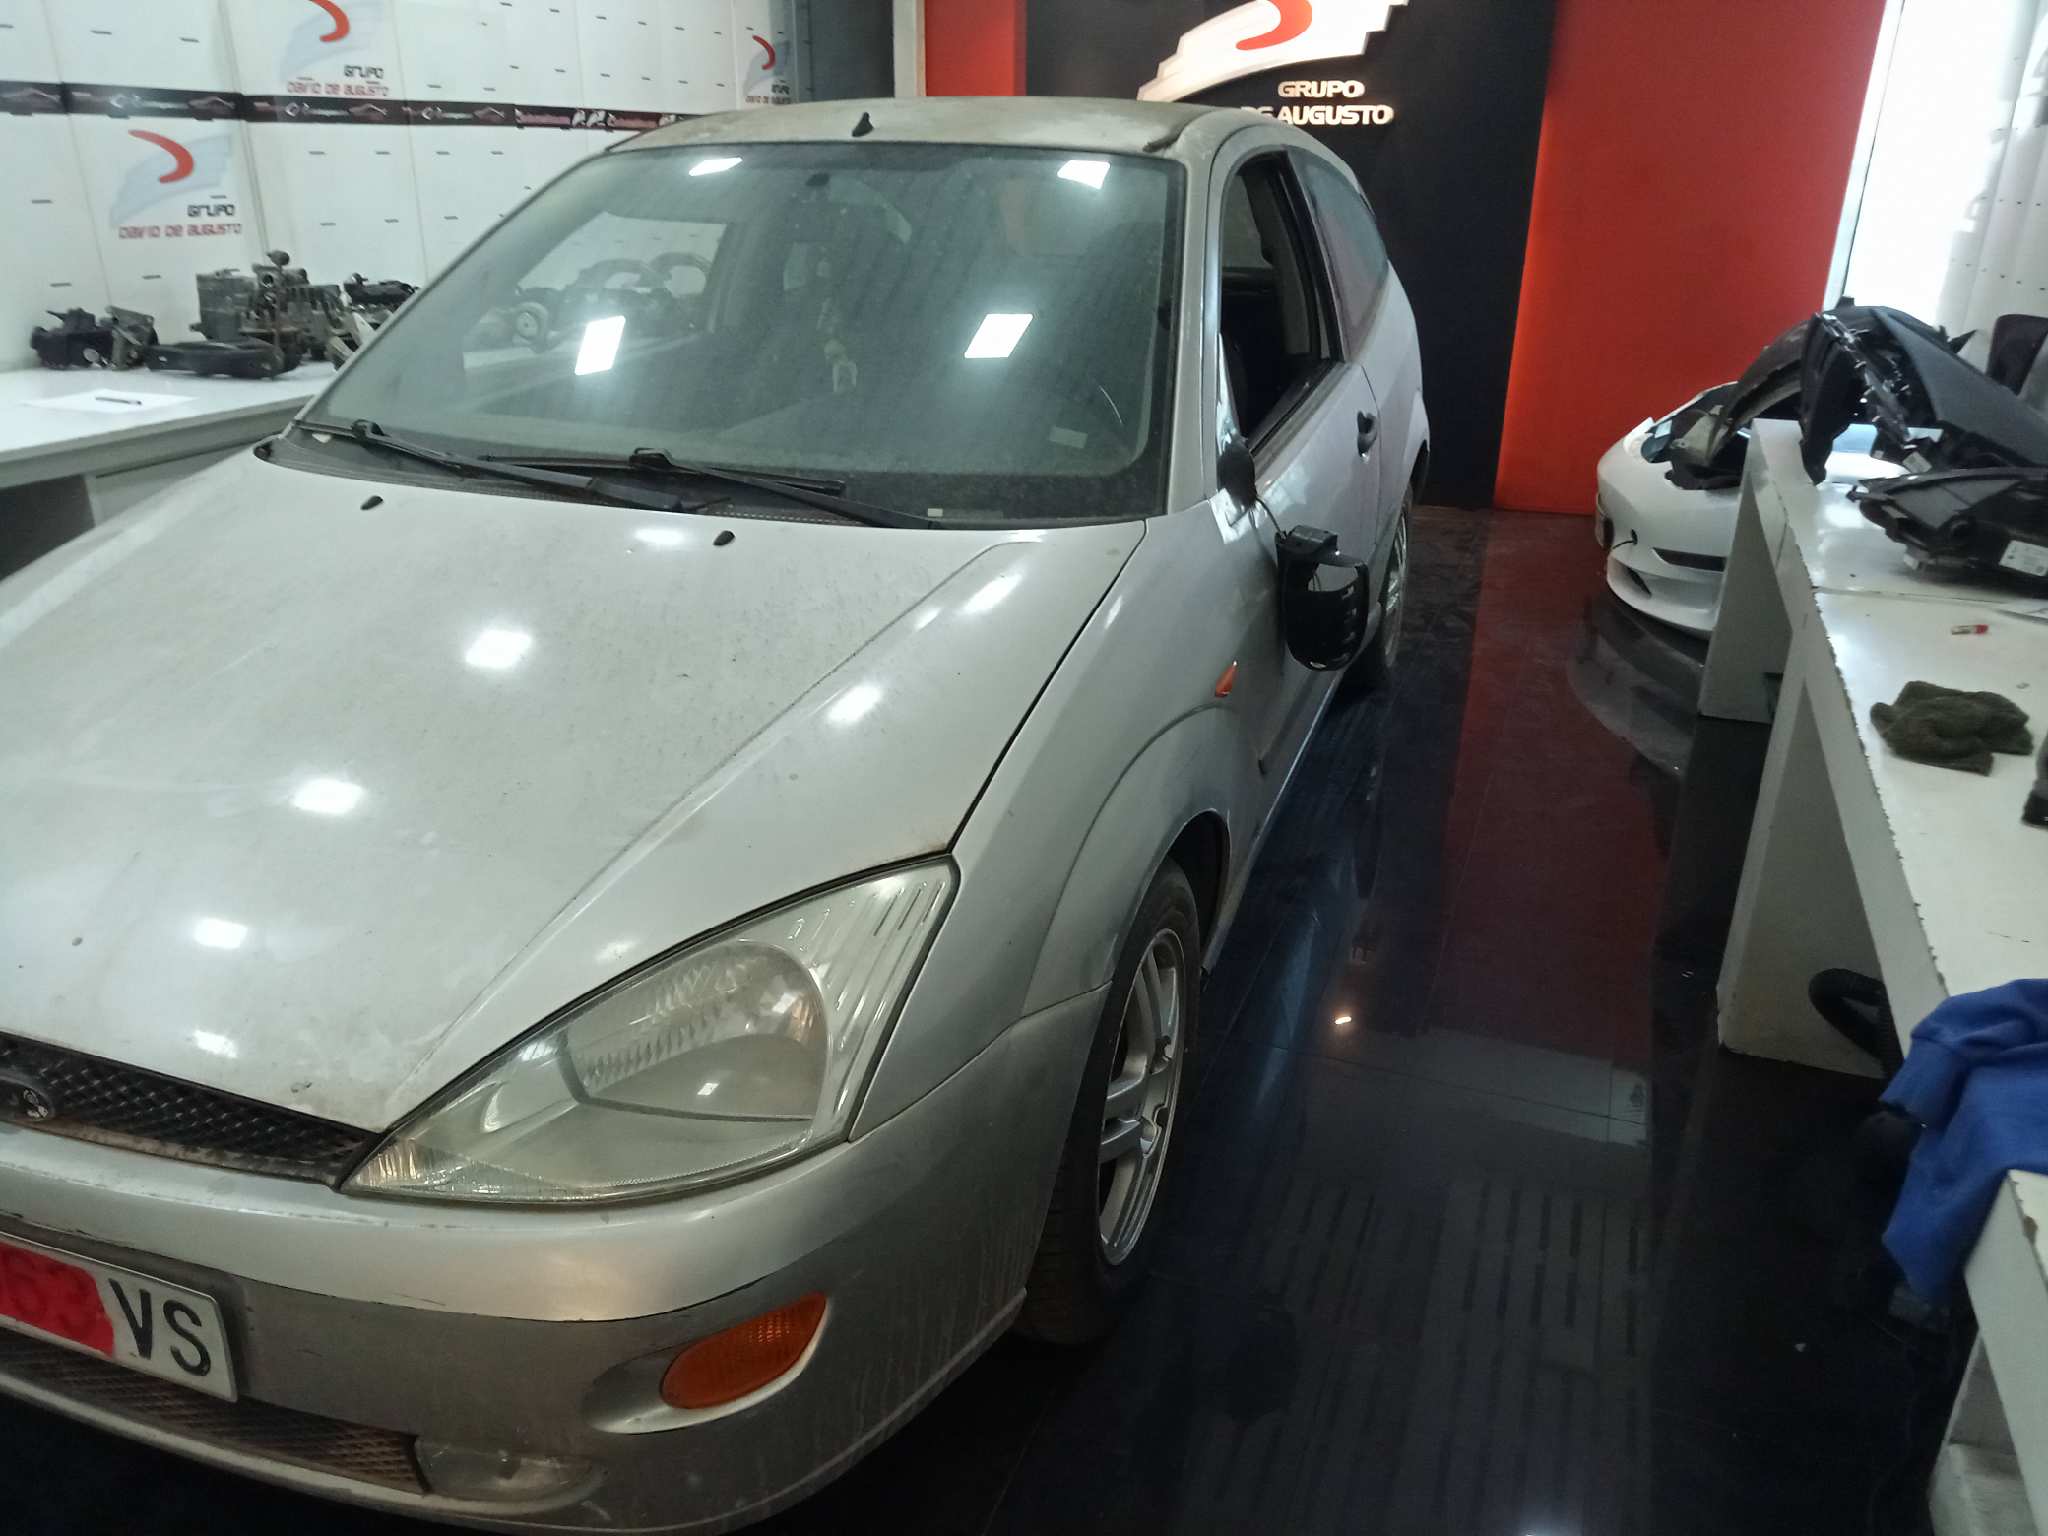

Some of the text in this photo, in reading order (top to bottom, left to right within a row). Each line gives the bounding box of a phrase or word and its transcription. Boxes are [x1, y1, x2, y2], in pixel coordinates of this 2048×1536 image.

[1278, 80, 1366, 98] GRUPO
[1276, 104, 1395, 126] AUGUSTO
[187, 203, 236, 218] GRUPO
[108, 1277, 212, 1377] VS
